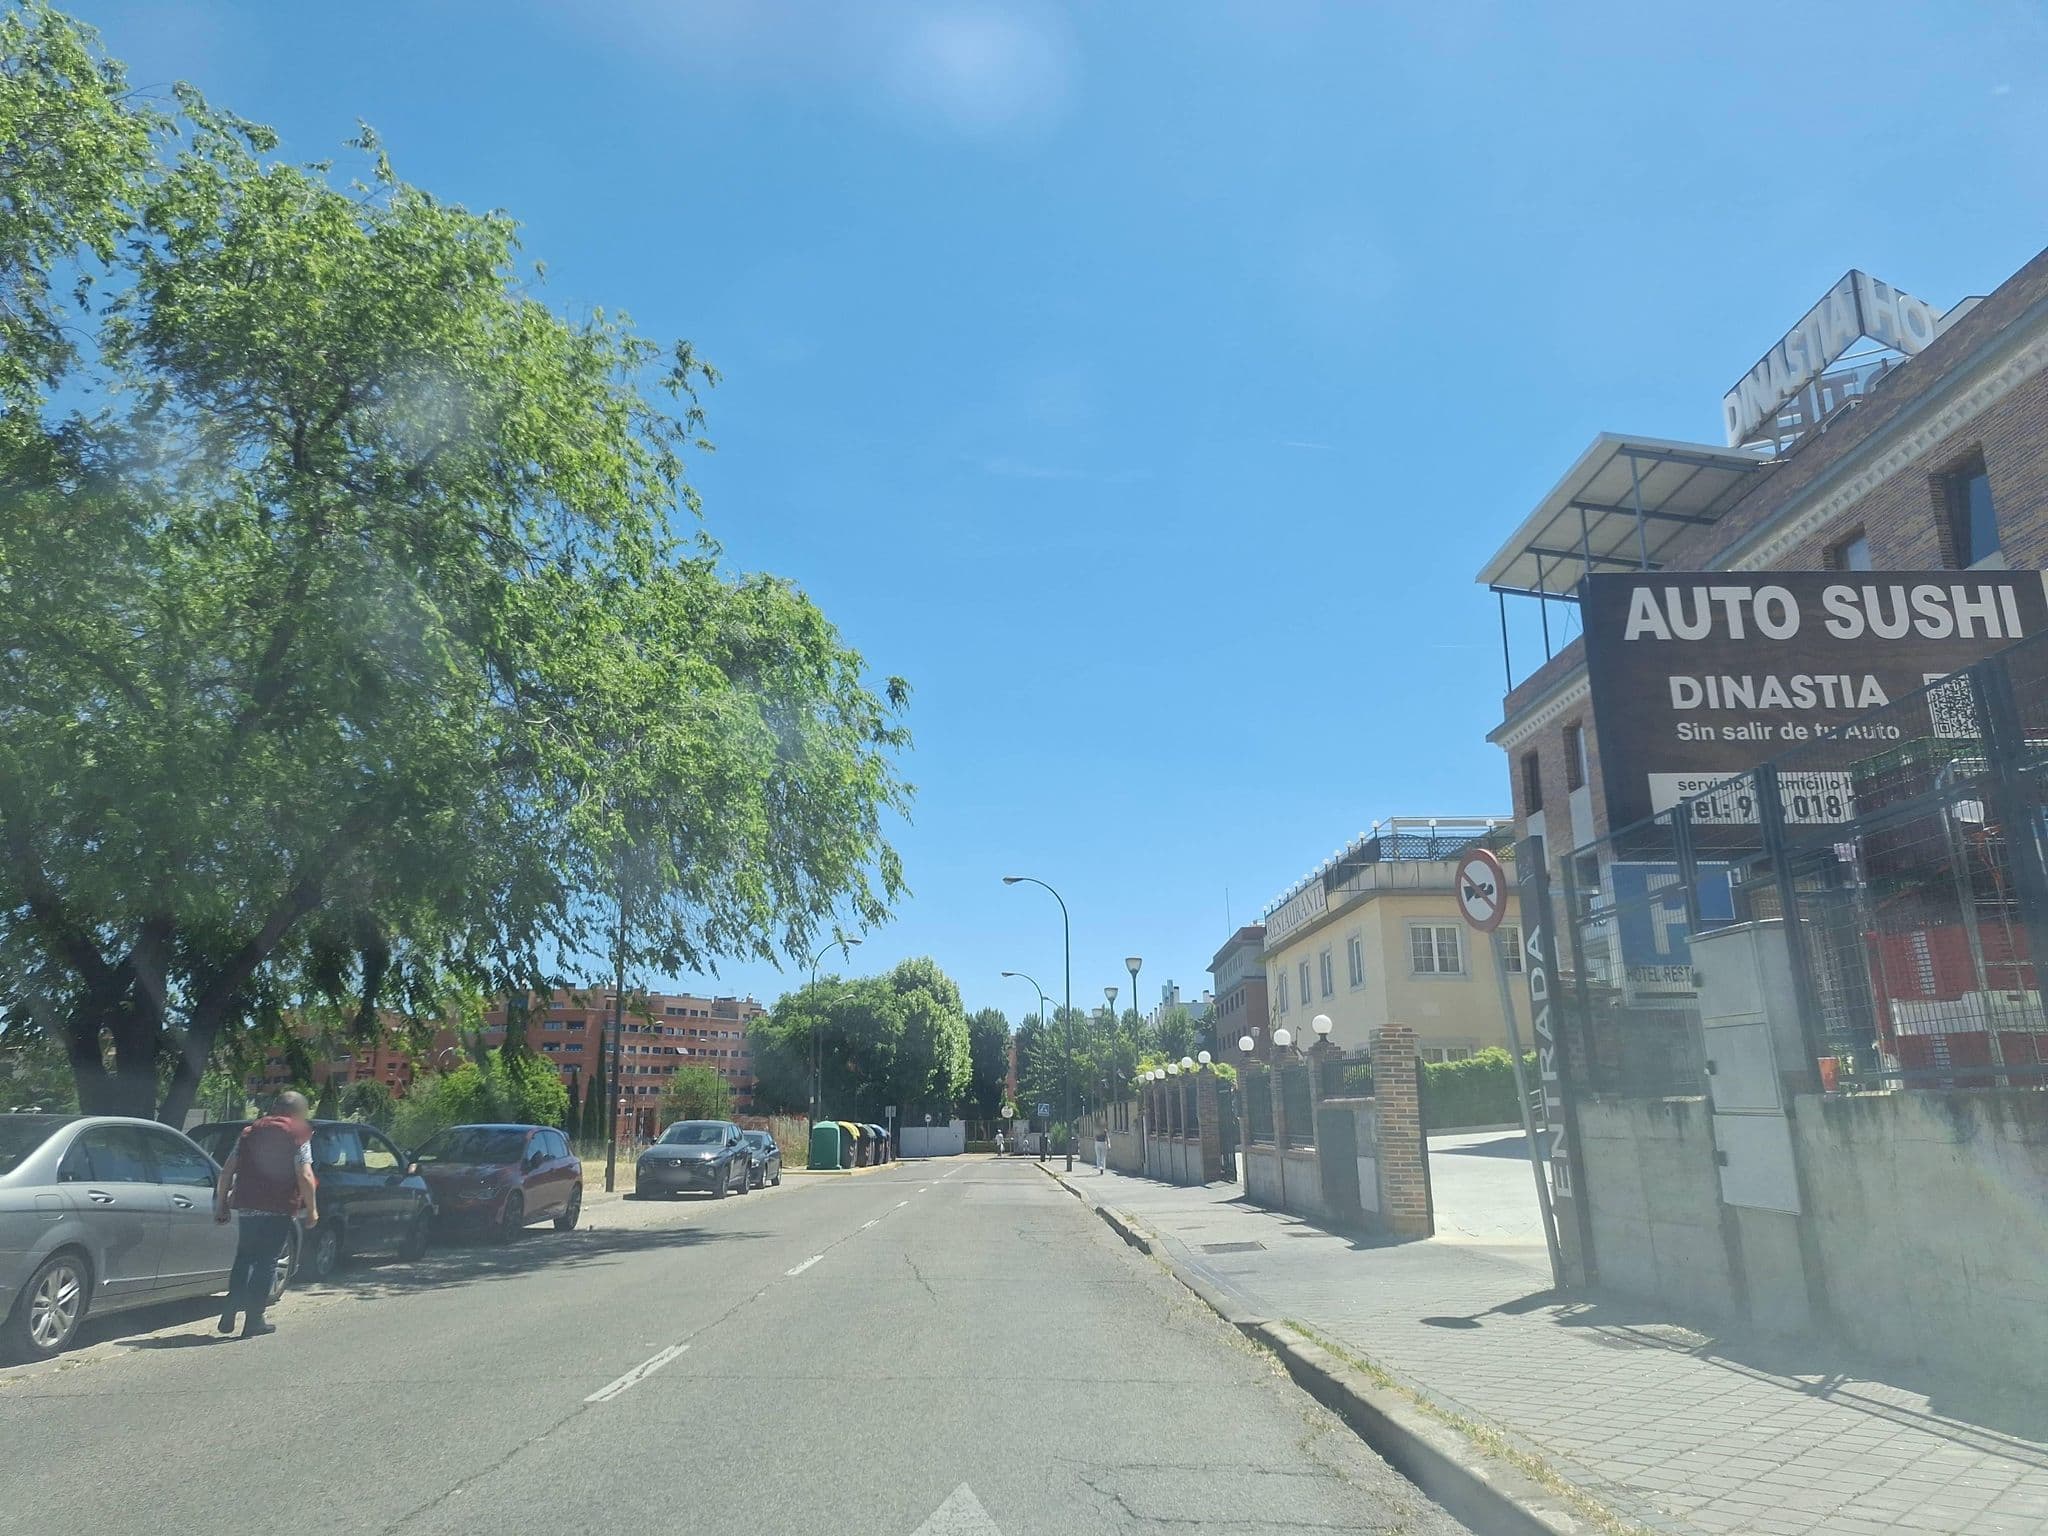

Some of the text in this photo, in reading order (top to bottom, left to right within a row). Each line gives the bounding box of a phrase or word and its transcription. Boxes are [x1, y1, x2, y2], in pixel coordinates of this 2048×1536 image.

[1864, 274, 1942, 353] HO
[1624, 585, 2024, 641] AUTO SUSHI
[1669, 675, 1889, 709] DINASTIA
[1676, 722, 1716, 741] Sin
[1722, 722, 1773, 740] salir
[1780, 722, 1808, 740] de
[1845, 723, 1900, 740] Auto
[1775, 777, 1840, 790] omicilio
[1267, 883, 1325, 939] RESTAURANTE
[1627, 966, 1661, 982] HOTEL
[1527, 924, 1573, 1198] ENTRADA
